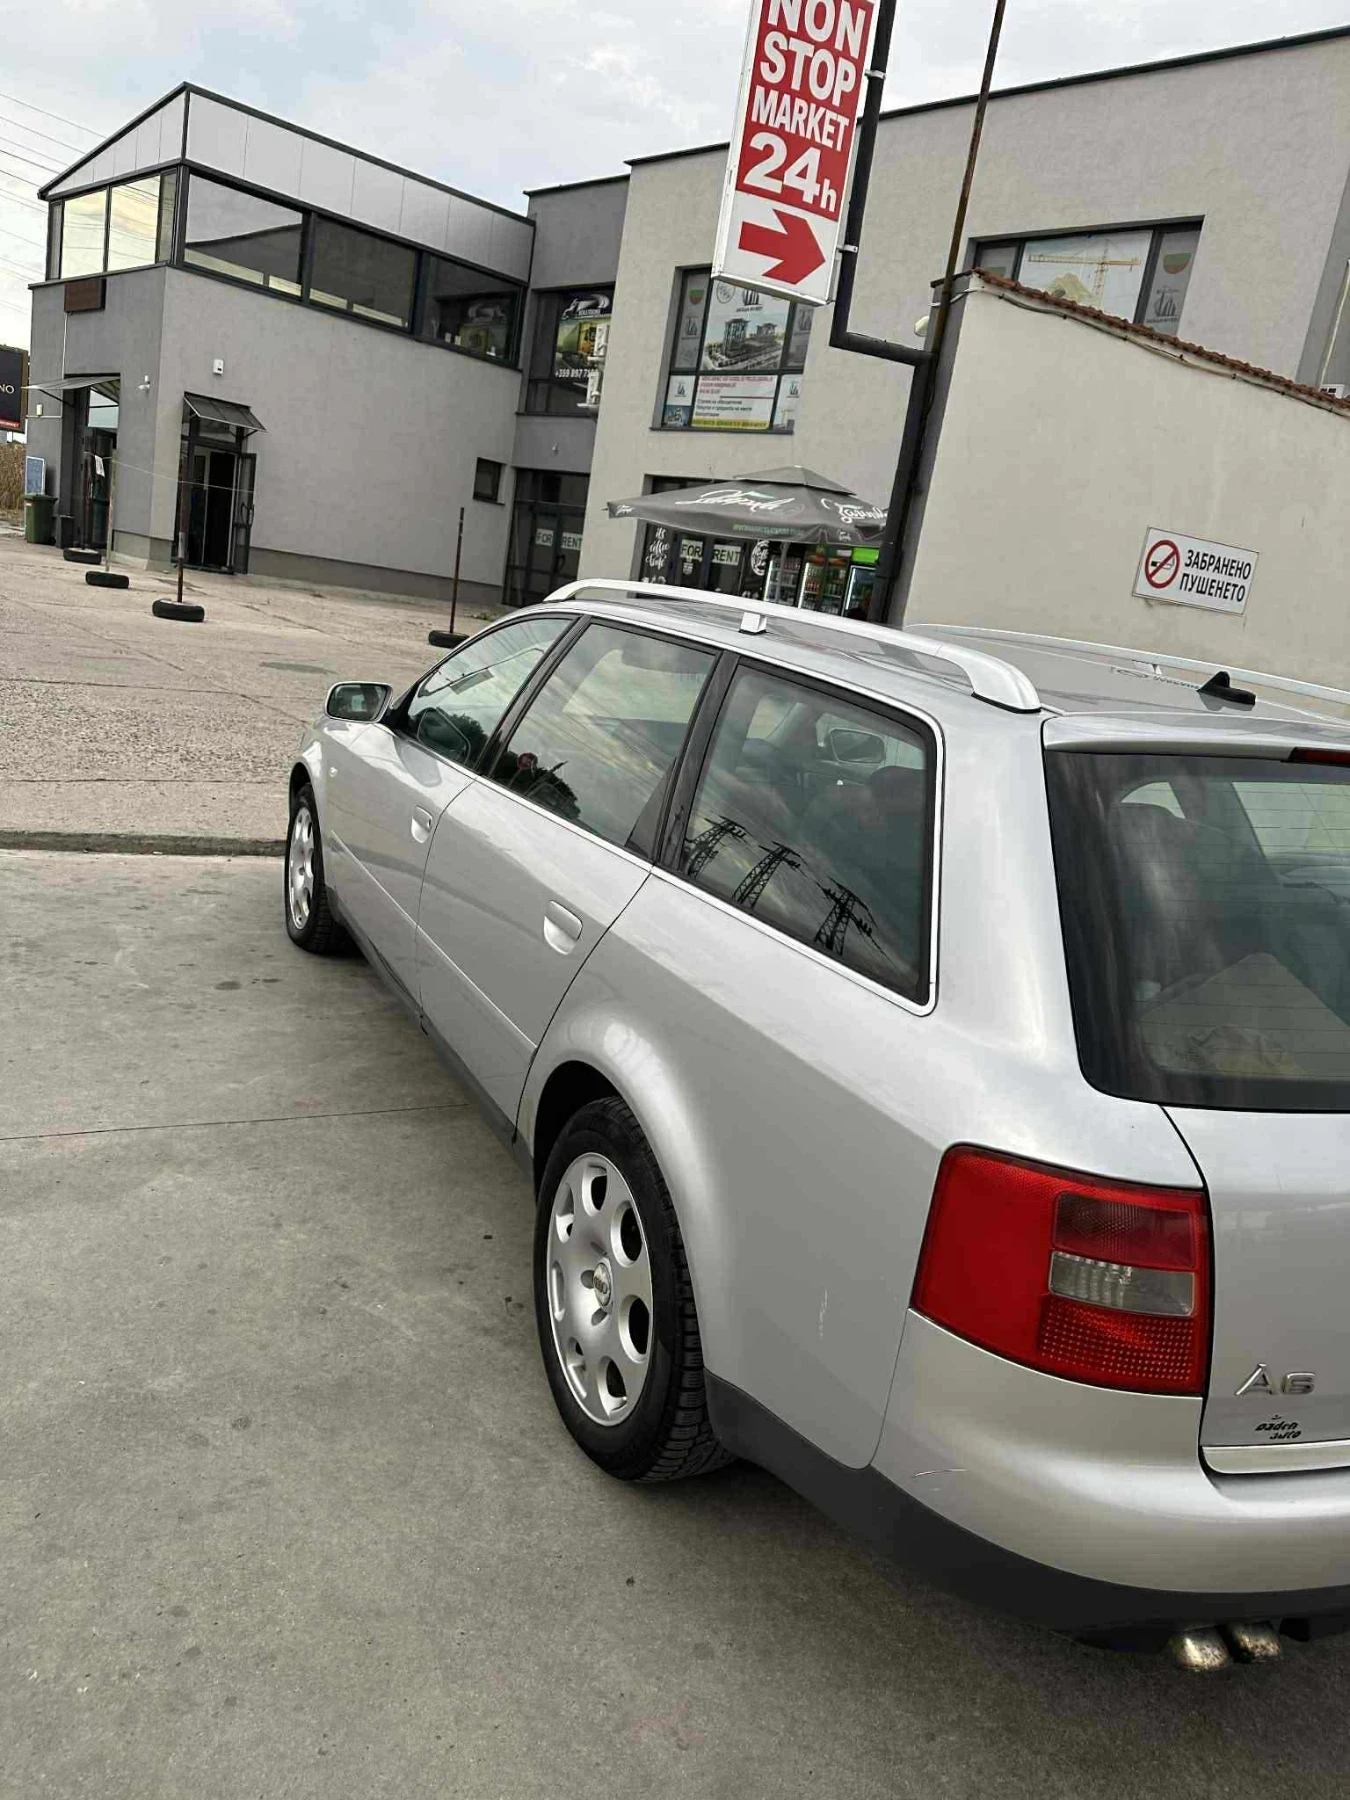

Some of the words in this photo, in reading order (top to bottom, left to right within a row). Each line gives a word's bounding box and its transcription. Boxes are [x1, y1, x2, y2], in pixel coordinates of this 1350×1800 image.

[767, 0, 866, 59] NON
[760, 31, 856, 106] STOP
[751, 84, 849, 152] MARKET
[743, 132, 837, 212] 24h
[537, 533, 552, 544] FOR
[562, 537, 582, 549] RENT
[682, 544, 703, 557] FOR
[713, 549, 740, 562] RENT
[1184, 549, 1252, 580] ЗАБРАНЕНО
[1179, 572, 1246, 602] ПУШЕНЕТО
[1235, 1363, 1316, 1395] A6
